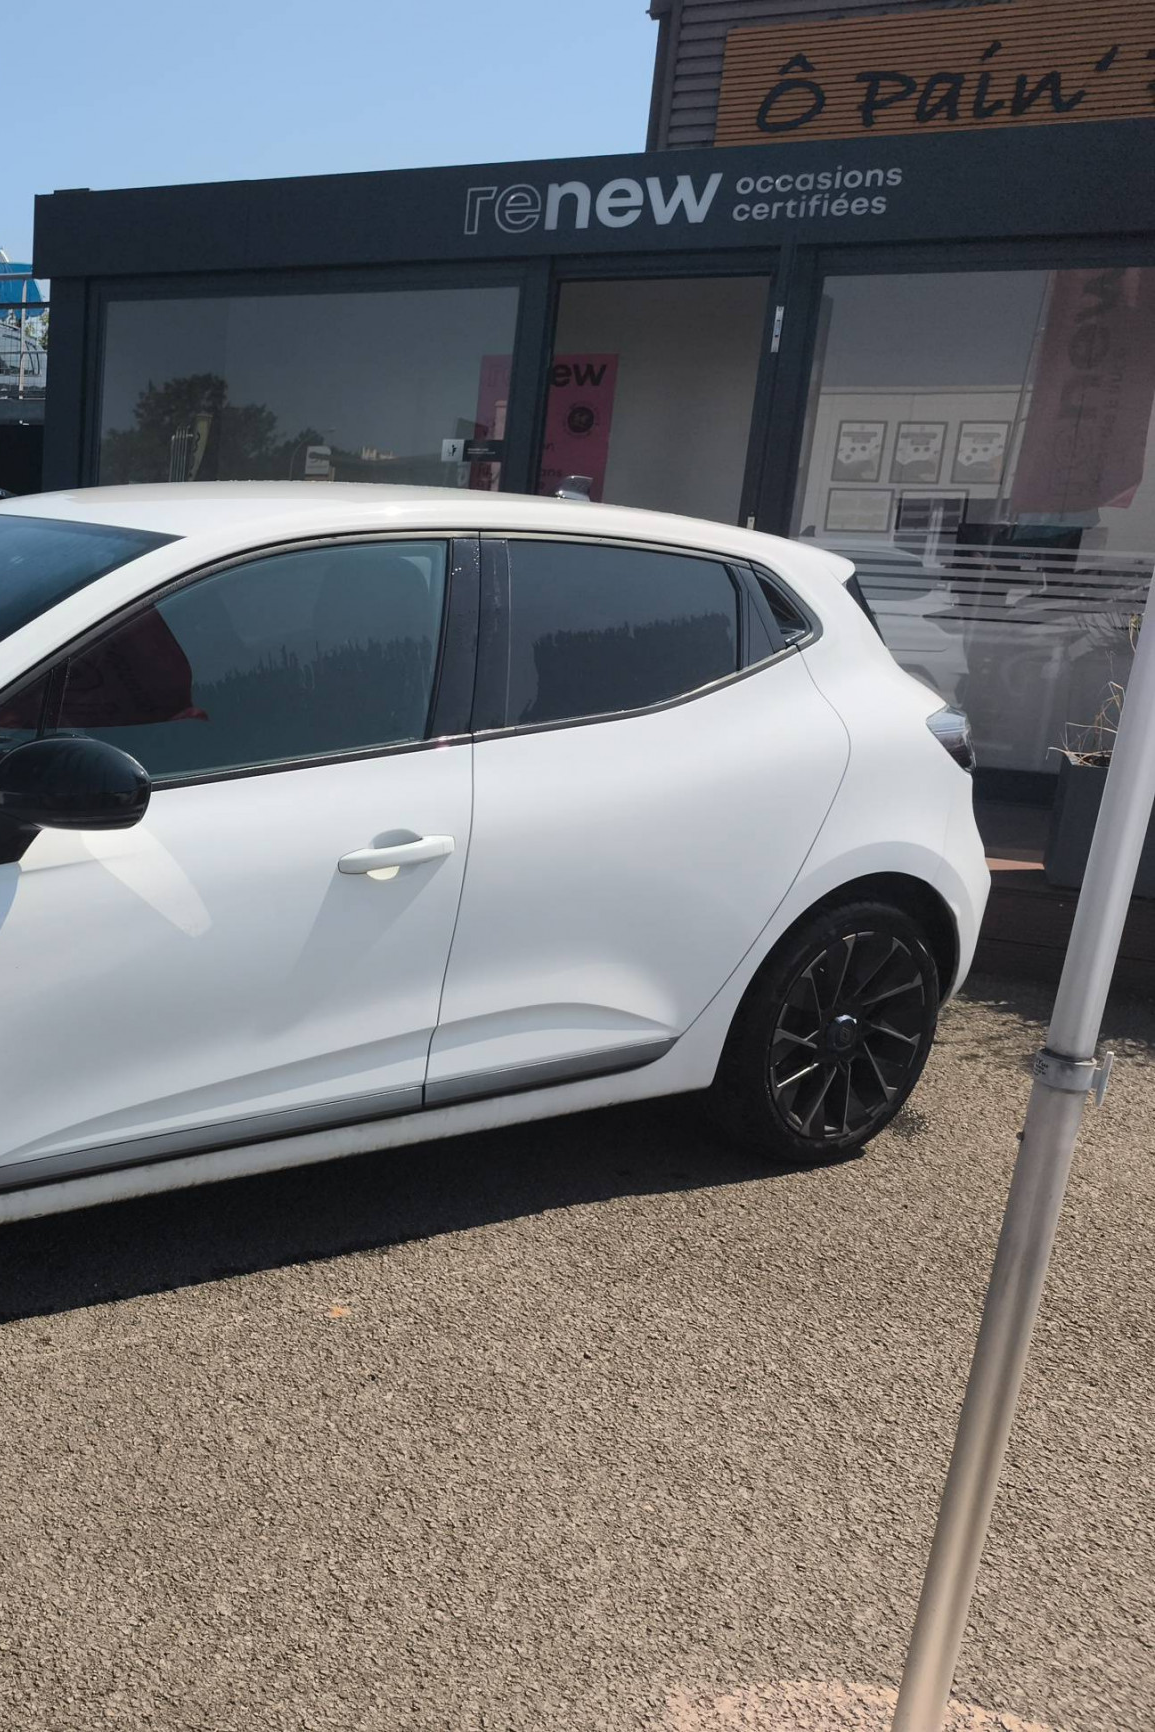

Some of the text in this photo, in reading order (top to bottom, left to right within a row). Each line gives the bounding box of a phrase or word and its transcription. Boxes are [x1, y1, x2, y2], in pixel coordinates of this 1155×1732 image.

[756, 40, 1155, 133] Ô Pain'
[736, 164, 903, 195] occasions
[463, 172, 724, 235] renew
[731, 193, 887, 222] certifiées
